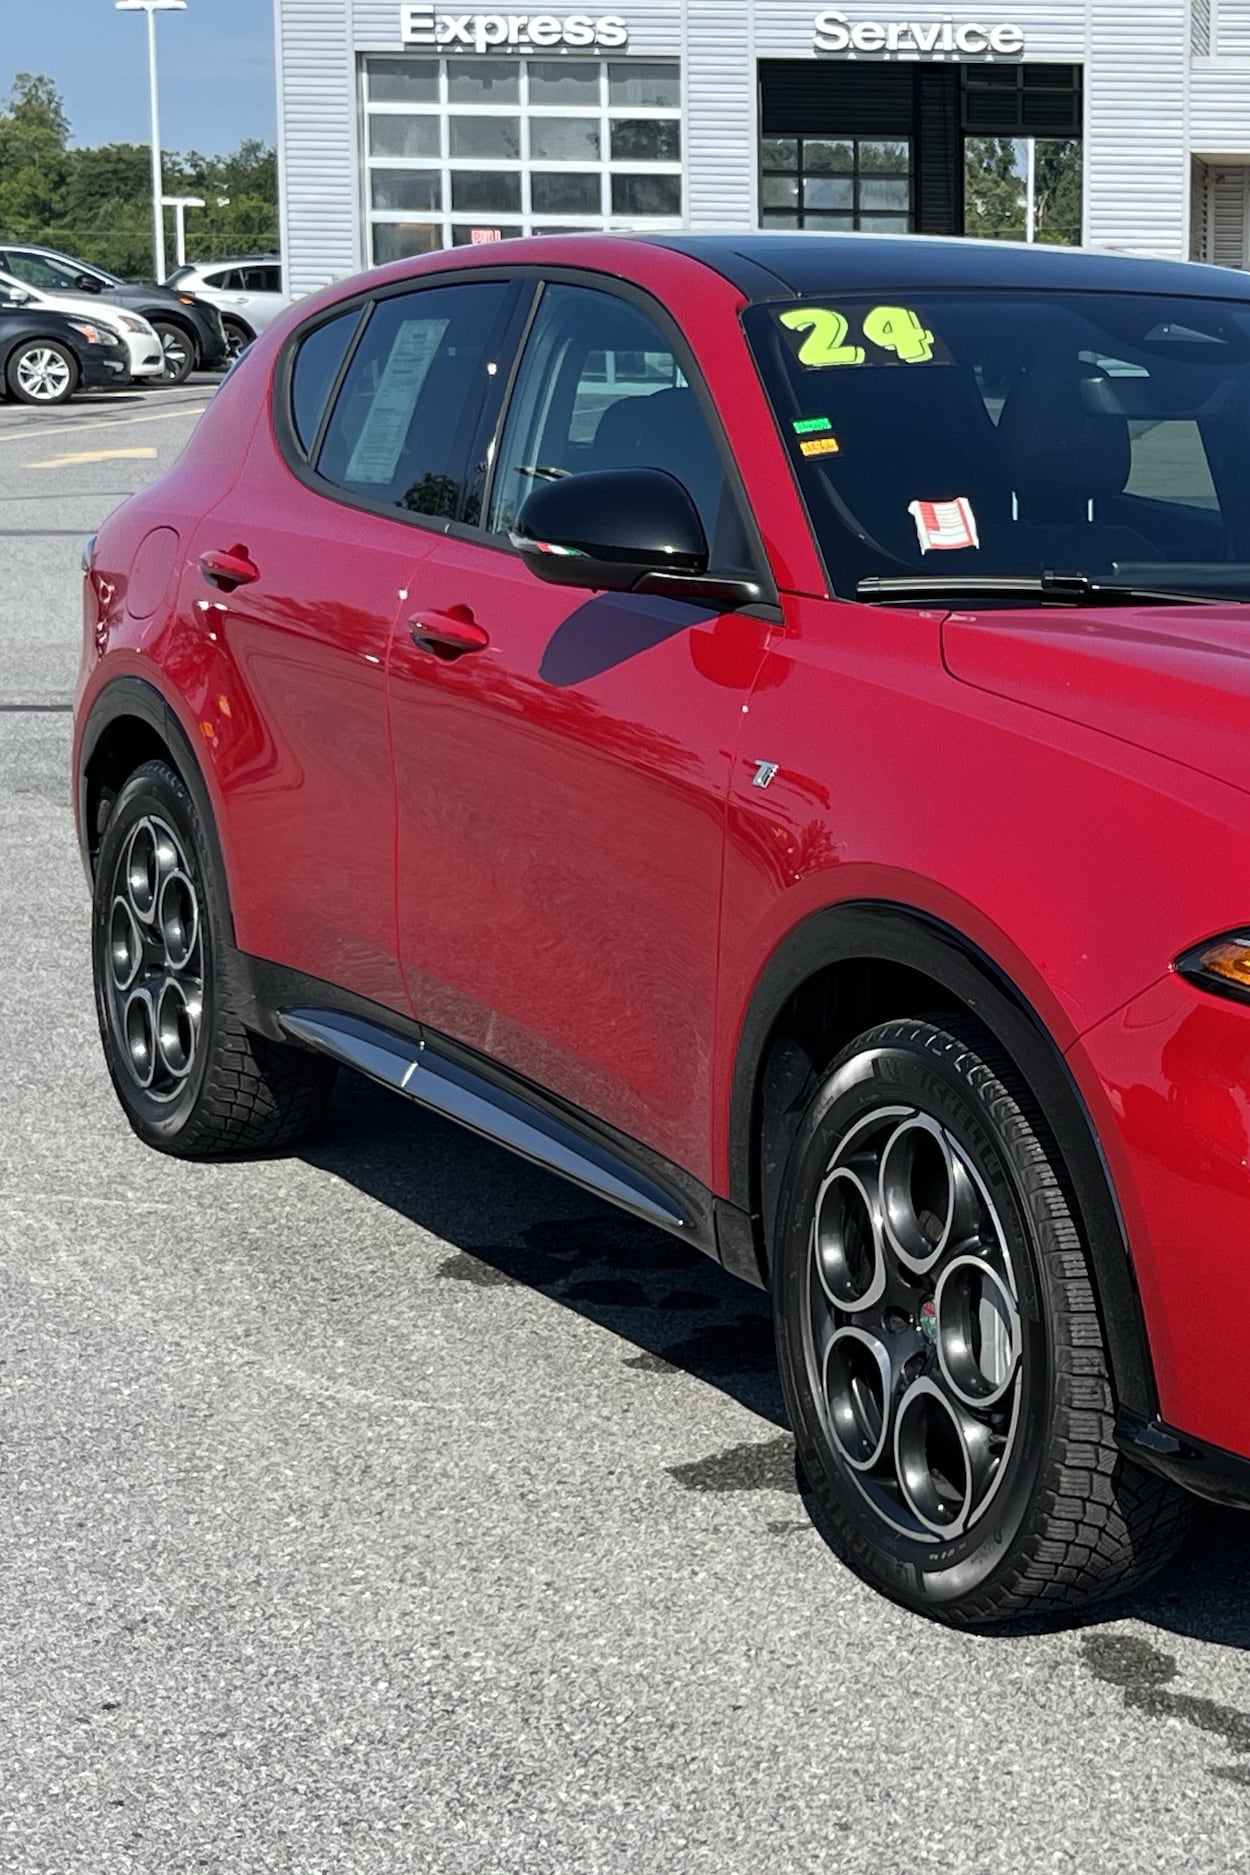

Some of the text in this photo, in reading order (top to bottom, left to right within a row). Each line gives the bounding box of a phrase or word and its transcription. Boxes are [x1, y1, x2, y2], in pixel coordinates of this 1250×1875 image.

[400, 4, 628, 53] Express
[812, 10, 1025, 53] Service
[779, 306, 934, 366] 24
